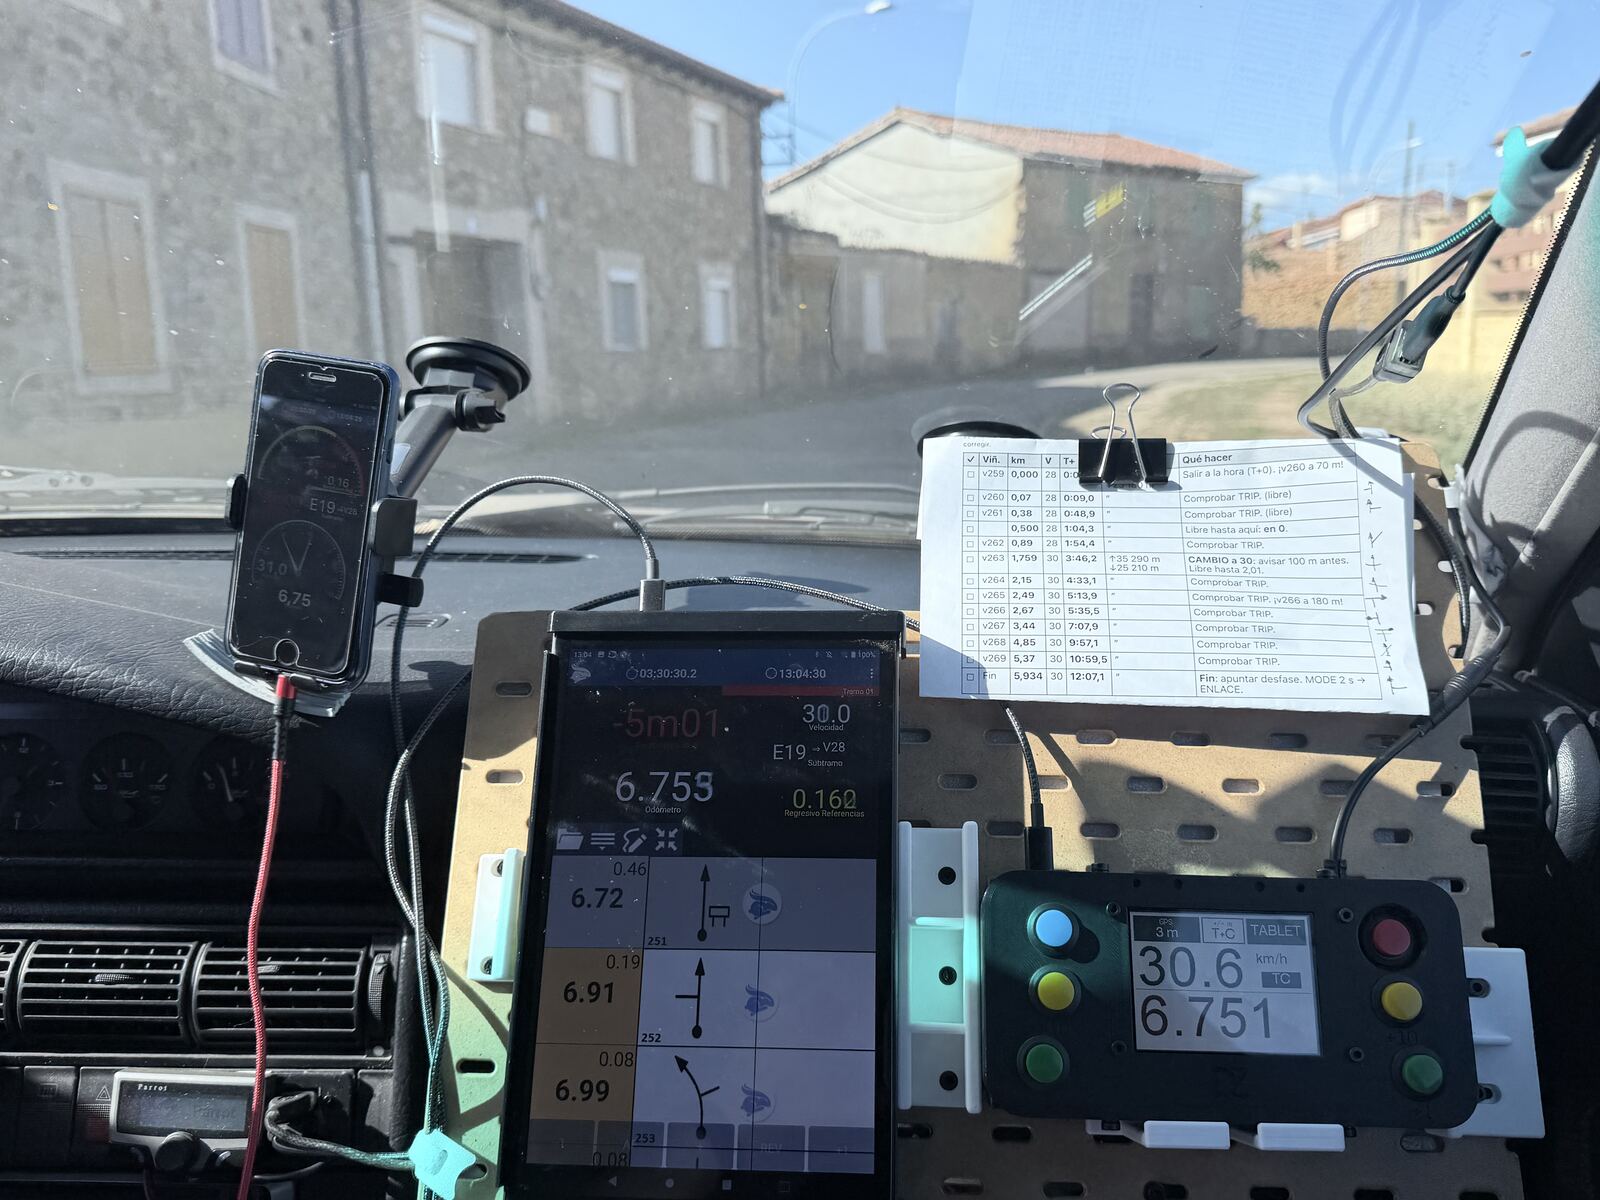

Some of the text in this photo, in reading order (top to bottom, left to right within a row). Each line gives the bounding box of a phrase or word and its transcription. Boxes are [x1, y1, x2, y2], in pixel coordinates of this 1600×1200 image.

[983, 455, 1000, 464] Viñ.
[1011, 456, 1025, 464] km
[1182, 453, 1232, 464] Qué hacer
[1223, 467, 1245, 476] hora
[1247, 466, 1275, 476] (T+0).
[1278, 464, 1306, 474] ¡v260
[1332, 460, 1344, 468] m!
[1011, 471, 1038, 479] 0,000
[1011, 494, 1031, 502] 0,07
[1064, 494, 1094, 503] 0:09,0
[1184, 490, 1292, 503] Comprobar TRIP. (libre)
[309, 498, 336, 514] E19
[1011, 510, 1032, 518] 0,38
[1064, 510, 1095, 519] 0:48,9
[1184, 508, 1292, 519] Comprobar TRIP. (libre)
[1011, 525, 1039, 533] 0,500
[1064, 525, 1094, 534] 1:04,3
[1238, 525, 1261, 535] aquí:
[1011, 539, 1033, 548] 0,89
[1065, 540, 1095, 548] 1:54,4
[1186, 541, 1238, 550] Comprobar
[1012, 554, 1037, 563] 1,759
[1065, 555, 1097, 564] 3:46,2
[1242, 566, 1264, 575] 2,01.
[1012, 577, 1032, 585] 2,15
[1066, 577, 1097, 586] 4:33,1
[1190, 578, 1269, 588] Comprobar TRIP.
[278, 589, 311, 607] 6,75
[1012, 592, 1034, 600] 2,49
[1067, 592, 1098, 601] 5:13,9
[1192, 594, 1244, 603] Comprobar
[1246, 595, 1271, 603] TRIP.
[1331, 597, 1343, 605] m!
[1013, 607, 1034, 616] 2,67
[1068, 607, 1100, 616] 5:35,5
[1194, 609, 1274, 618] Comprobar TRIP.
[1013, 622, 1035, 631] 3,44
[1068, 622, 1099, 632] 7:07,9
[1195, 624, 1250, 634] Comprobar
[1014, 639, 1036, 647] 4,85
[1069, 639, 1098, 648] 9:57,1
[1196, 641, 1251, 650] Comprobar
[1014, 655, 1035, 664] 5,37
[1070, 655, 1108, 665] 10:59,5
[1198, 657, 1280, 667] Comprobar TRIP.
[639, 669, 697, 678] 03:30:30.2
[779, 669, 826, 679] 13:04:30
[1014, 672, 1043, 682] 5,934
[1071, 673, 1104, 683] 12:07,1
[1220, 676, 1258, 685] apuntar
[1260, 675, 1302, 684] desfase.
[1200, 685, 1243, 694] ENLACE.
[809, 723, 844, 732] Velocidad
[773, 742, 845, 760] E19 V28
[807, 759, 843, 767] Subtramo
[645, 806, 681, 814] Odómetro
[784, 809, 865, 818] Regresivo Referencias
[613, 862, 647, 877] 0.46
[571, 888, 624, 909] 6.72
[1155, 927, 1179, 937] 3 m
[1212, 928, 1235, 940] T+C
[1250, 924, 1300, 937] TABLET
[648, 936, 667, 946] 251
[606, 955, 640, 970] 0.19
[1256, 953, 1288, 965] km/h
[1139, 945, 1243, 988] 30.6
[1272, 973, 1291, 984] TC
[563, 982, 614, 1004] 6.91
[1140, 994, 1271, 1039] 6.751
[641, 1033, 661, 1043] 252
[599, 1052, 634, 1067] 0.08
[555, 1080, 610, 1102] 6.99
[635, 1133, 655, 1143] 253
